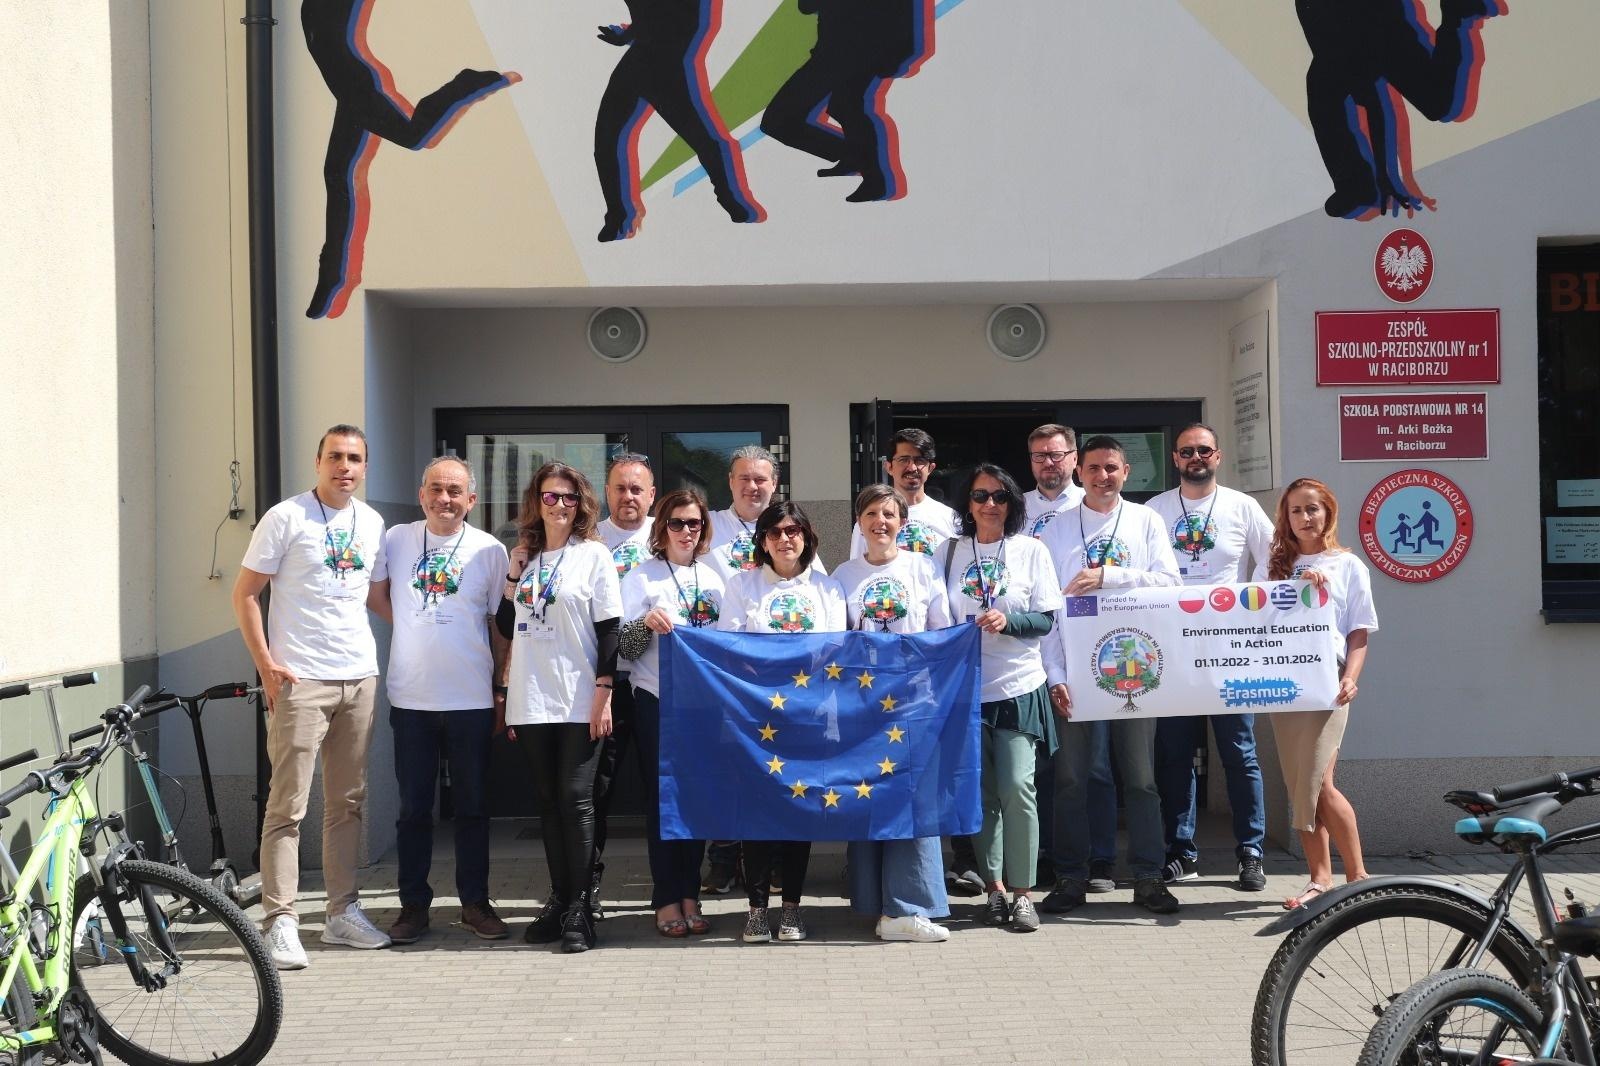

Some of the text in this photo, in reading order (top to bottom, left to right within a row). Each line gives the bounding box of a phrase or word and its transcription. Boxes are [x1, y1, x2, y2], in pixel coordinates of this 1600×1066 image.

[1387, 316, 1429, 338] ZESPÓŁ
[1328, 341, 1488, 359] SZKOLNO-PRZEDSZKOLNY nr 1
[1368, 361, 1448, 377] W RACIBORZU
[1343, 402, 1484, 417] SZKOŁA PODSTAWOWA NR 14
[1377, 423, 1453, 435] im. Arki Bożka
[1384, 440, 1446, 451] w Raciborzu
[1365, 473, 1467, 517] BEZPIECZNA SZKOŁA
[1363, 532, 1432, 579] BEZPIECZNY
[1436, 533, 1468, 572] UCZEŃ
[1182, 623, 1330, 637] Environmental Education
[1230, 639, 1283, 649] in Action
[1194, 657, 1250, 668] 01.11.2022
[1262, 654, 1322, 666] 31.01.2024
[1150, 649, 1164, 690] DUCATION
[1226, 686, 1297, 700] Erasmus+
[61, 848, 77, 976] ROCKRIDER
